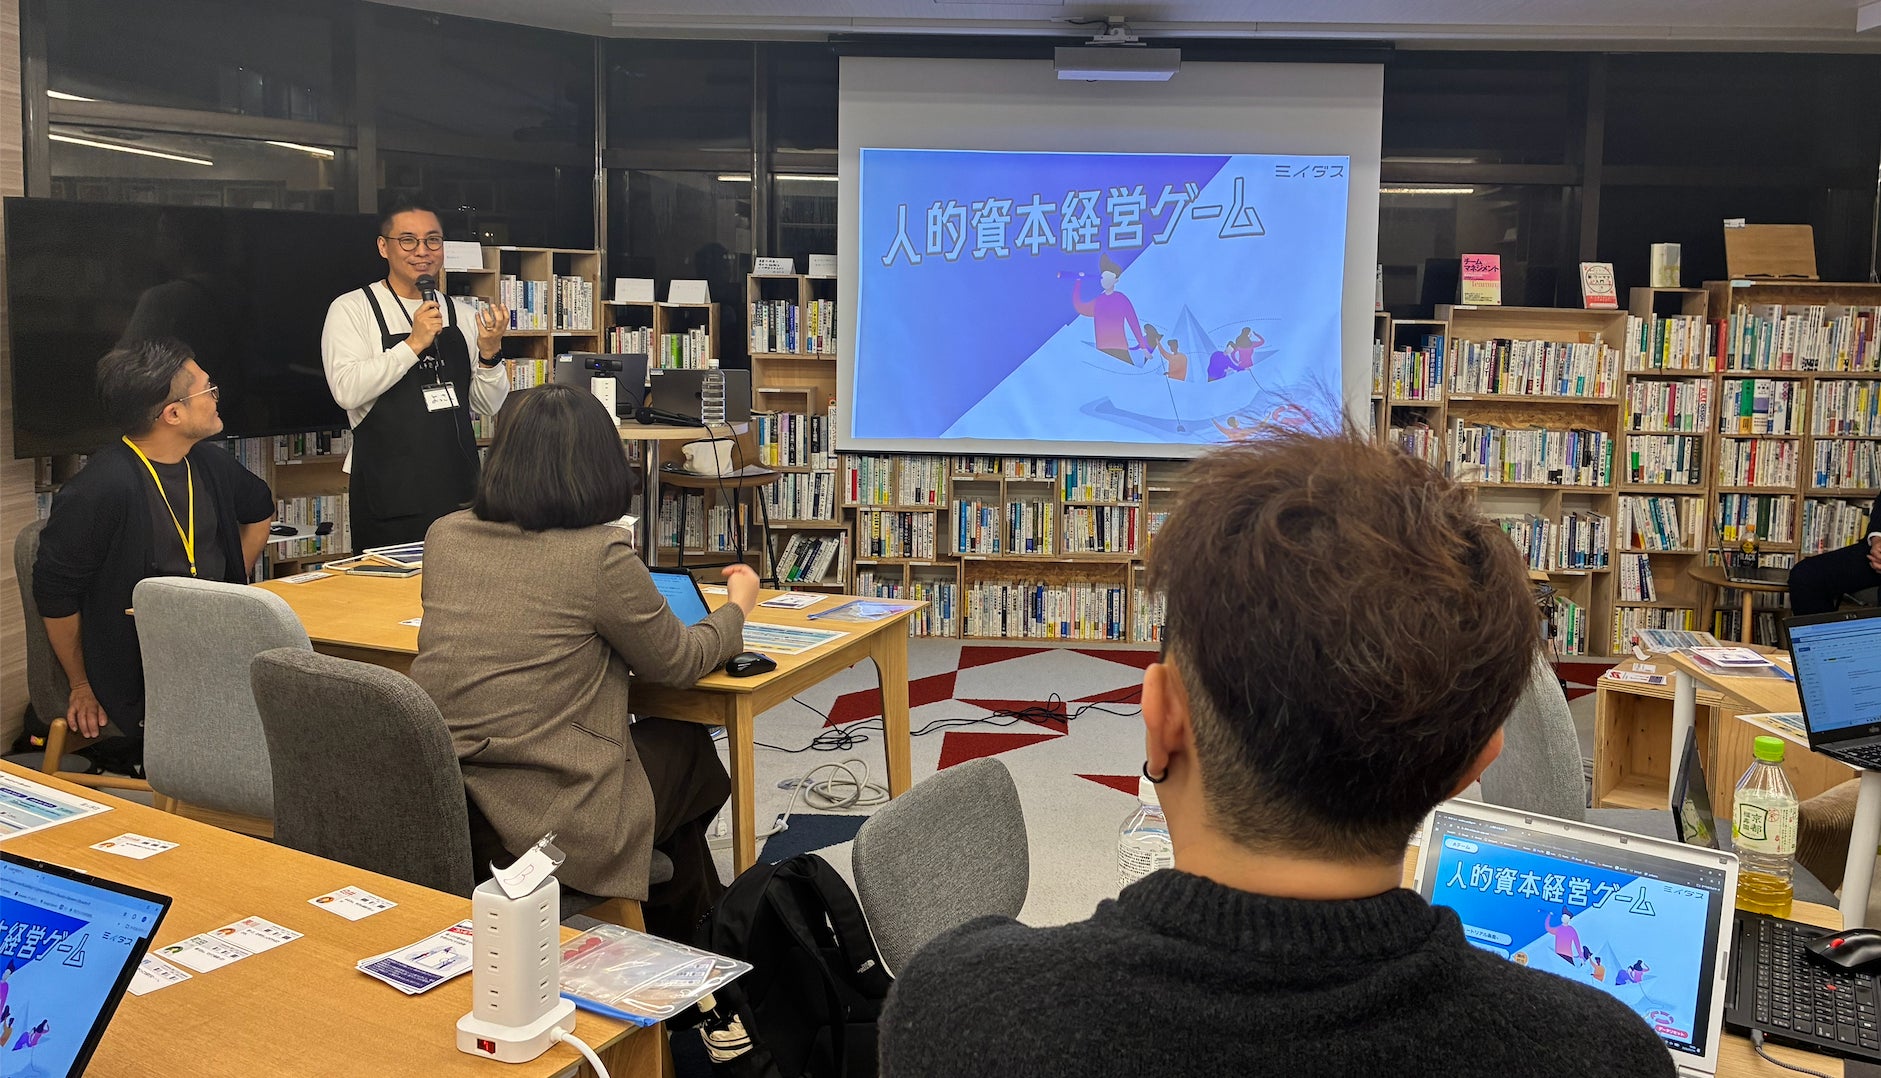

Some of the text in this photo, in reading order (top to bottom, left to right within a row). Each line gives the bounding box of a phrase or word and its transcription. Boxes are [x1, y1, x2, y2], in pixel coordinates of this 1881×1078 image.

[1275, 164, 1344, 179] ミイダス
[882, 177, 1266, 268] 人的資本経営ゲーム
[1463, 256, 1483, 265] チーム
[1463, 264, 1500, 273] マネジメント
[1750, 812, 1763, 835] 京都
[1446, 860, 1656, 917] 人的資本経営ゲーム
[1663, 885, 1704, 900] ミイダス
[102, 931, 134, 947] ミイダス
